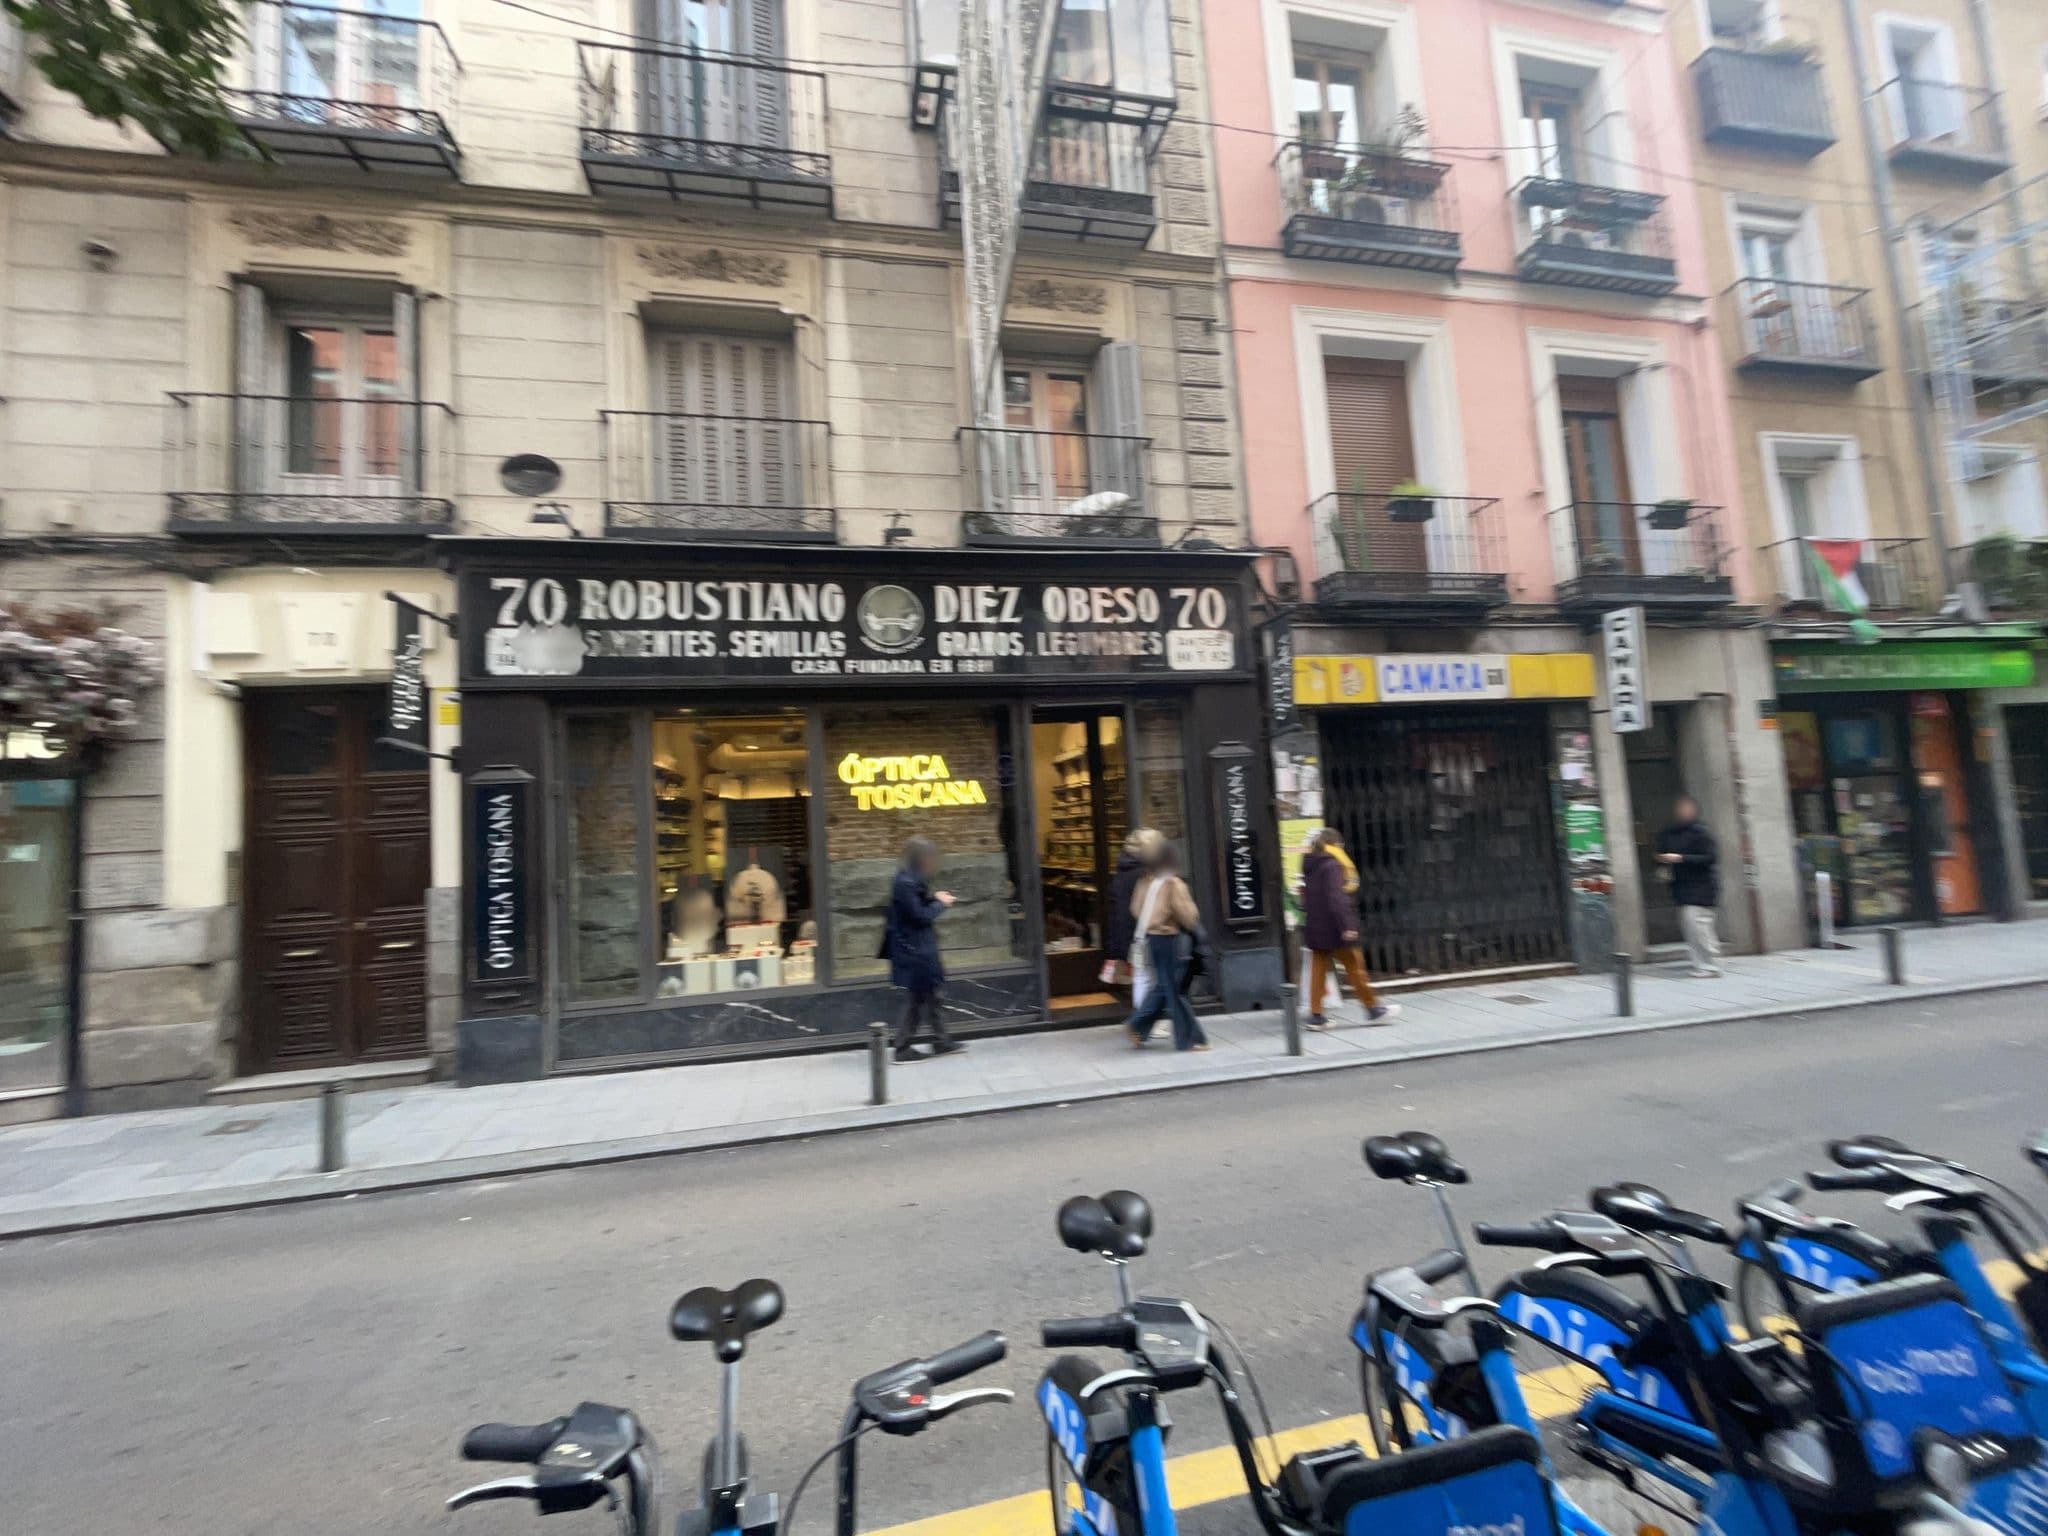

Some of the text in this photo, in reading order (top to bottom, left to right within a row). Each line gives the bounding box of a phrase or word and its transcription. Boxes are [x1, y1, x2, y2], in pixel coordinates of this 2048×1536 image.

[490, 578, 845, 625] 70 ROBUSTIANO
[934, 585, 1226, 628] DIEZ OBESO 70
[791, 660, 841, 674] CASA
[838, 753, 950, 784] ÓPTICA
[850, 780, 987, 811] TOSCANA
[1226, 765, 1249, 843] TOSCANA
[487, 794, 514, 888] TOSCANA
